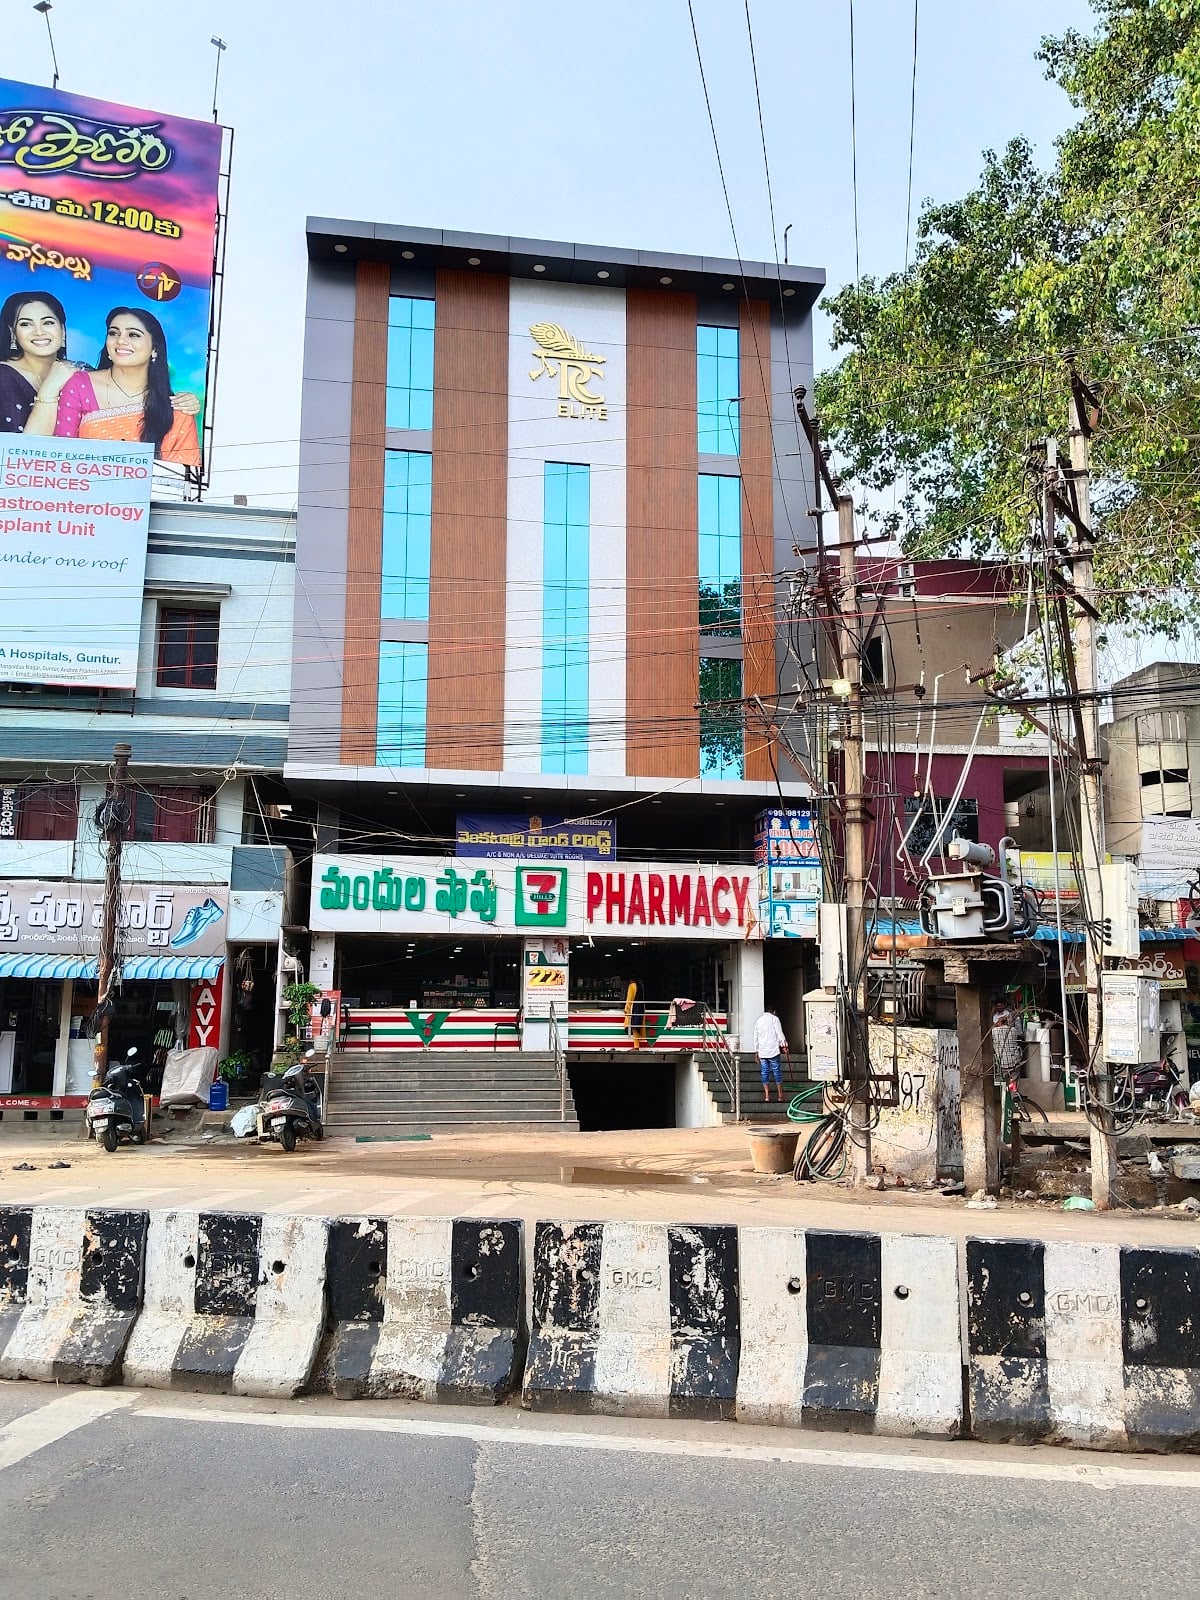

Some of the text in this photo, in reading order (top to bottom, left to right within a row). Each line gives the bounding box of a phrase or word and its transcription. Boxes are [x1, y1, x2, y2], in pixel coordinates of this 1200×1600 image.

[558, 404, 608, 421] ELITE
[8, 448, 149, 465] CENTRE OF EXCELLENCE FOR
[6, 457, 148, 479] LIVER & GASTRO
[5, 473, 91, 492] SCIENCES
[57, 520, 96, 537] Unit
[0, 550, 128, 573] under one roof
[10, 648, 72, 663] Hospitals,
[76, 652, 122, 665] Guntur.
[320, 866, 426, 912] మందుల
[586, 872, 751, 927] PHARMACY
[36, 1246, 77, 1265] GMC
[612, 1271, 654, 1285] GMC
[824, 1280, 875, 1301] GMC
[1056, 1293, 1112, 1314] GMC
